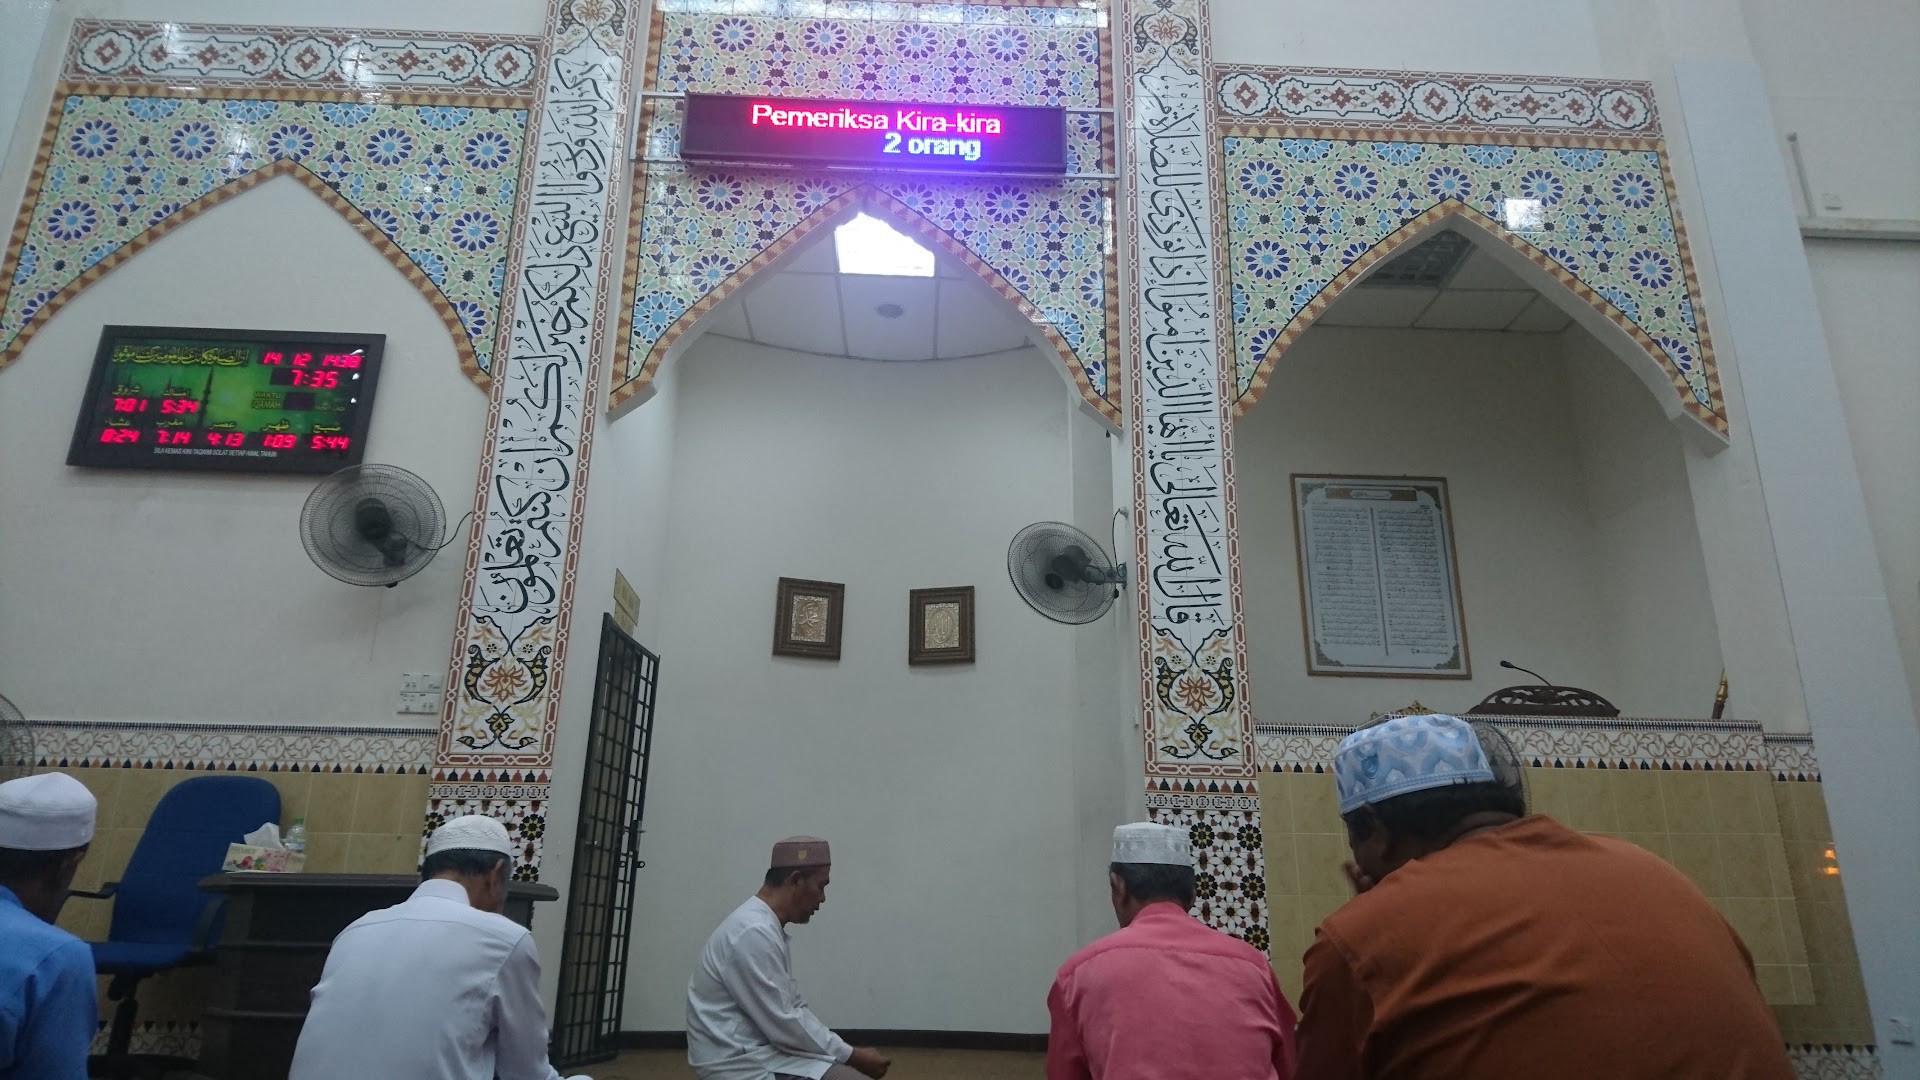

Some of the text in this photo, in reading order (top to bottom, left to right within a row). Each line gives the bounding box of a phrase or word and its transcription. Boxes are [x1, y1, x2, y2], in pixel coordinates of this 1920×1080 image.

[752, 104, 1001, 134] Pemeriksa Kira-kira
[883, 132, 981, 161] 2 orang
[263, 352, 282, 365] 14
[293, 353, 312, 367] 12
[291, 369, 339, 388] 7:35
[311, 435, 350, 450] 5:44
